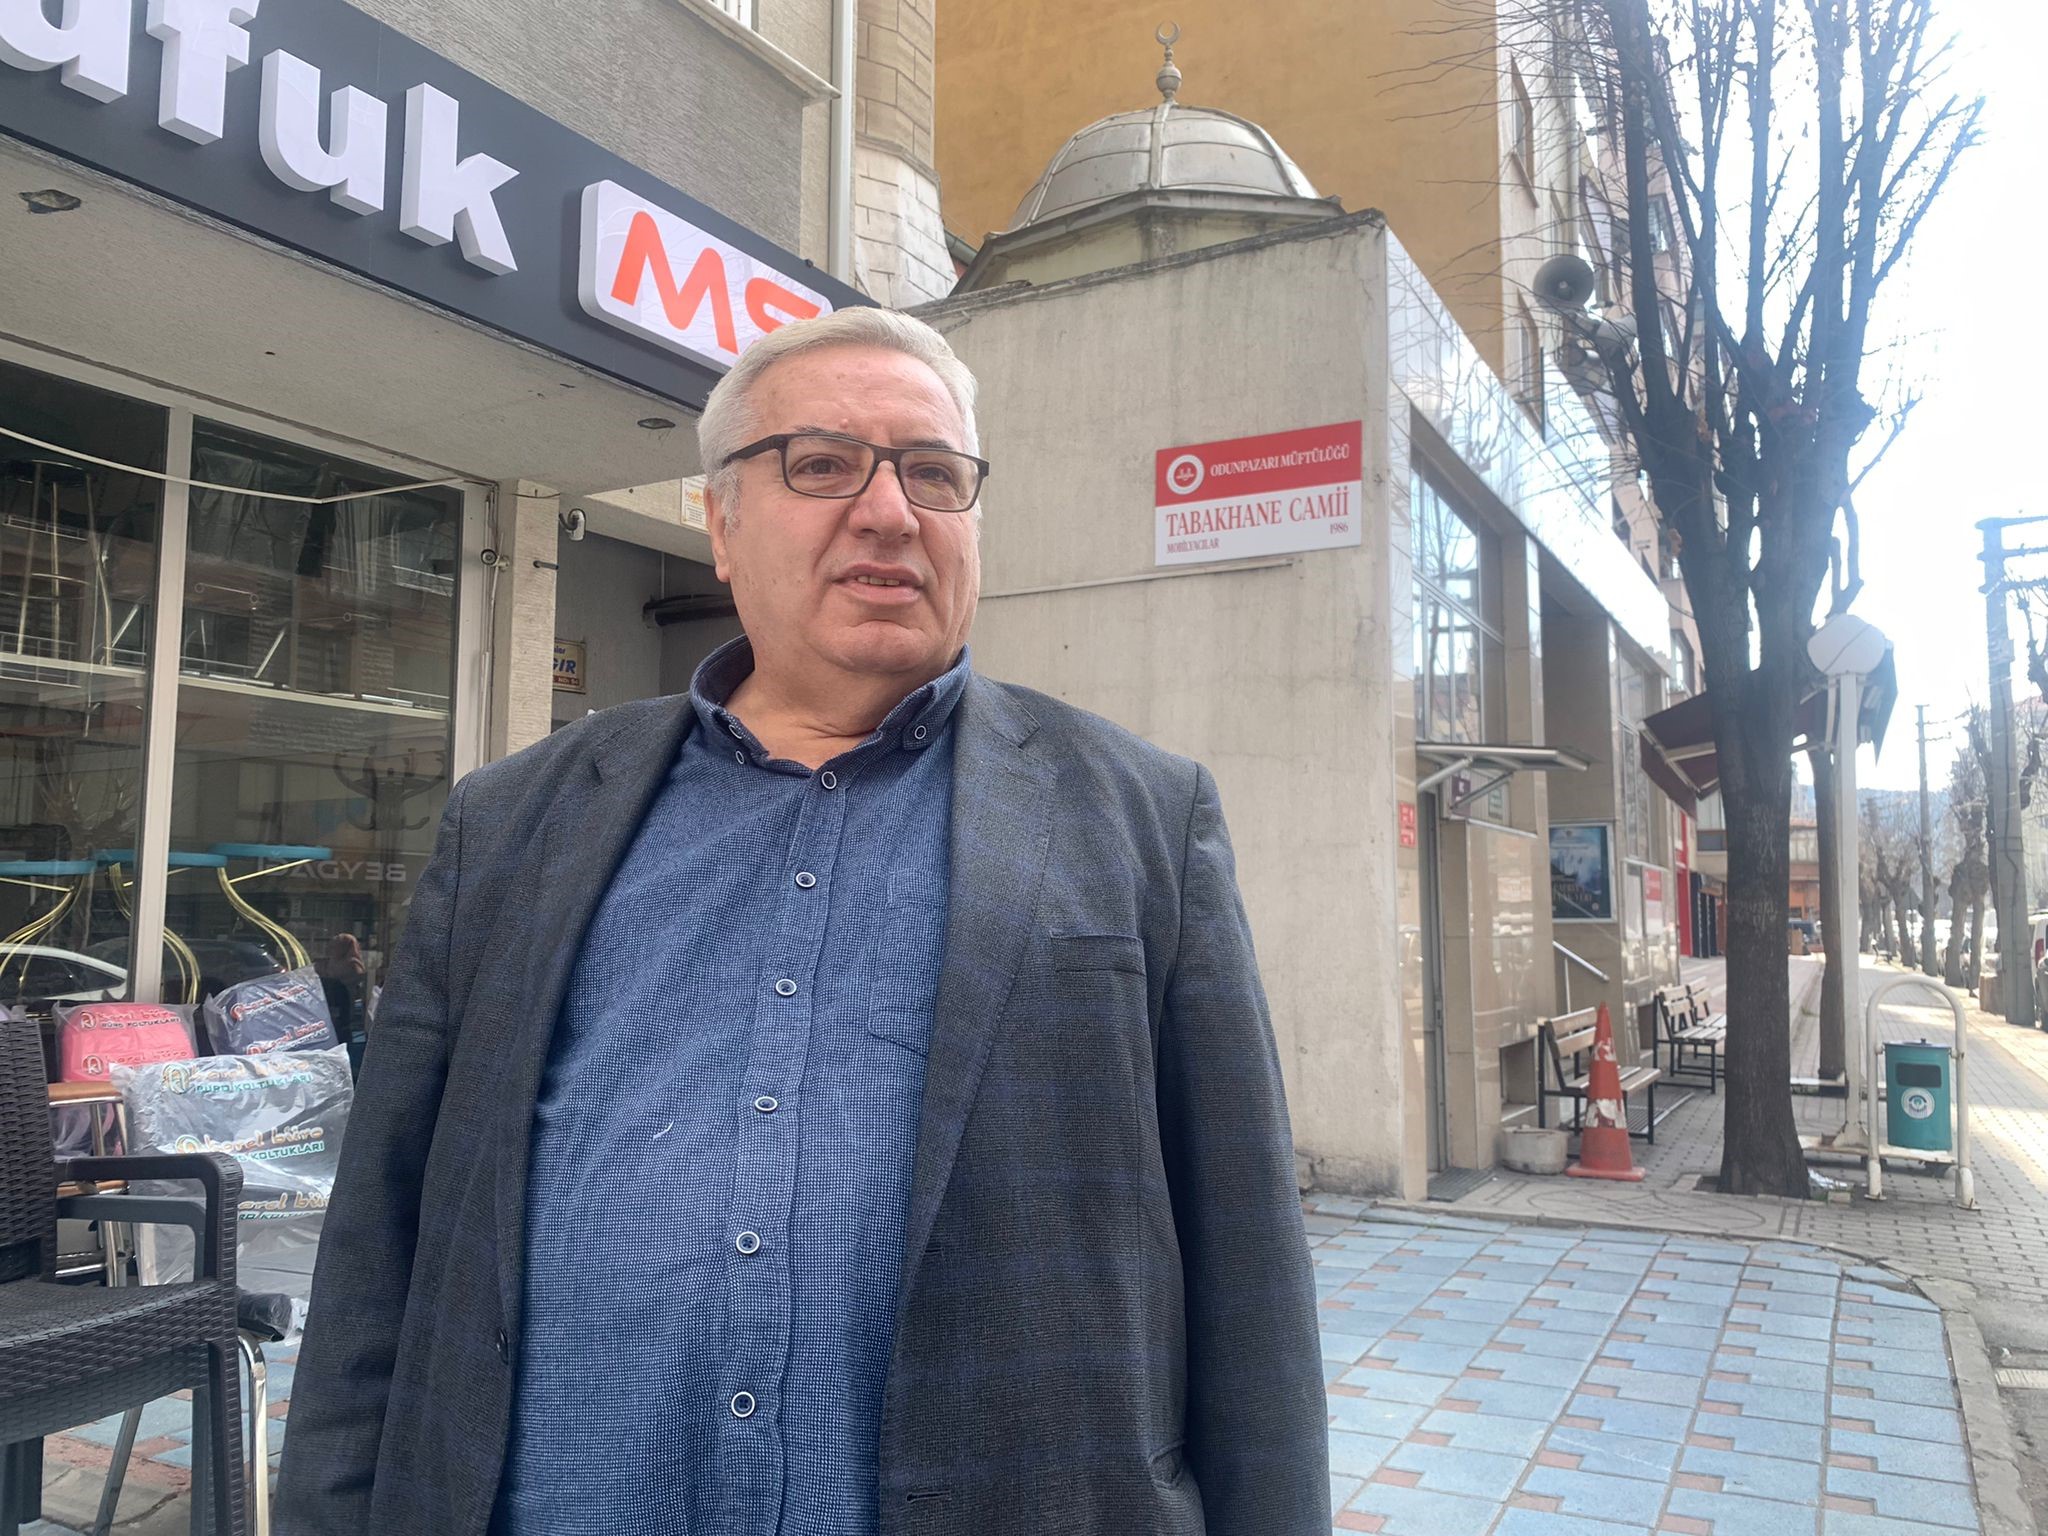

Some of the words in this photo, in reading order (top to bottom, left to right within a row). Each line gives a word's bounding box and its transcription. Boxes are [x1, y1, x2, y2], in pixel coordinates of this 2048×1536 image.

[1210, 456, 1280, 477] ODUNPAZARI
[1280, 443, 1350, 468] MÜFTÜLÜĞÜ
[1166, 501, 1282, 537] TABAKHANE
[1289, 486, 1349, 522] CAMİİ
[250, 1141, 325, 1161] KOLTUKLARI
[238, 1192, 288, 1210] arel
